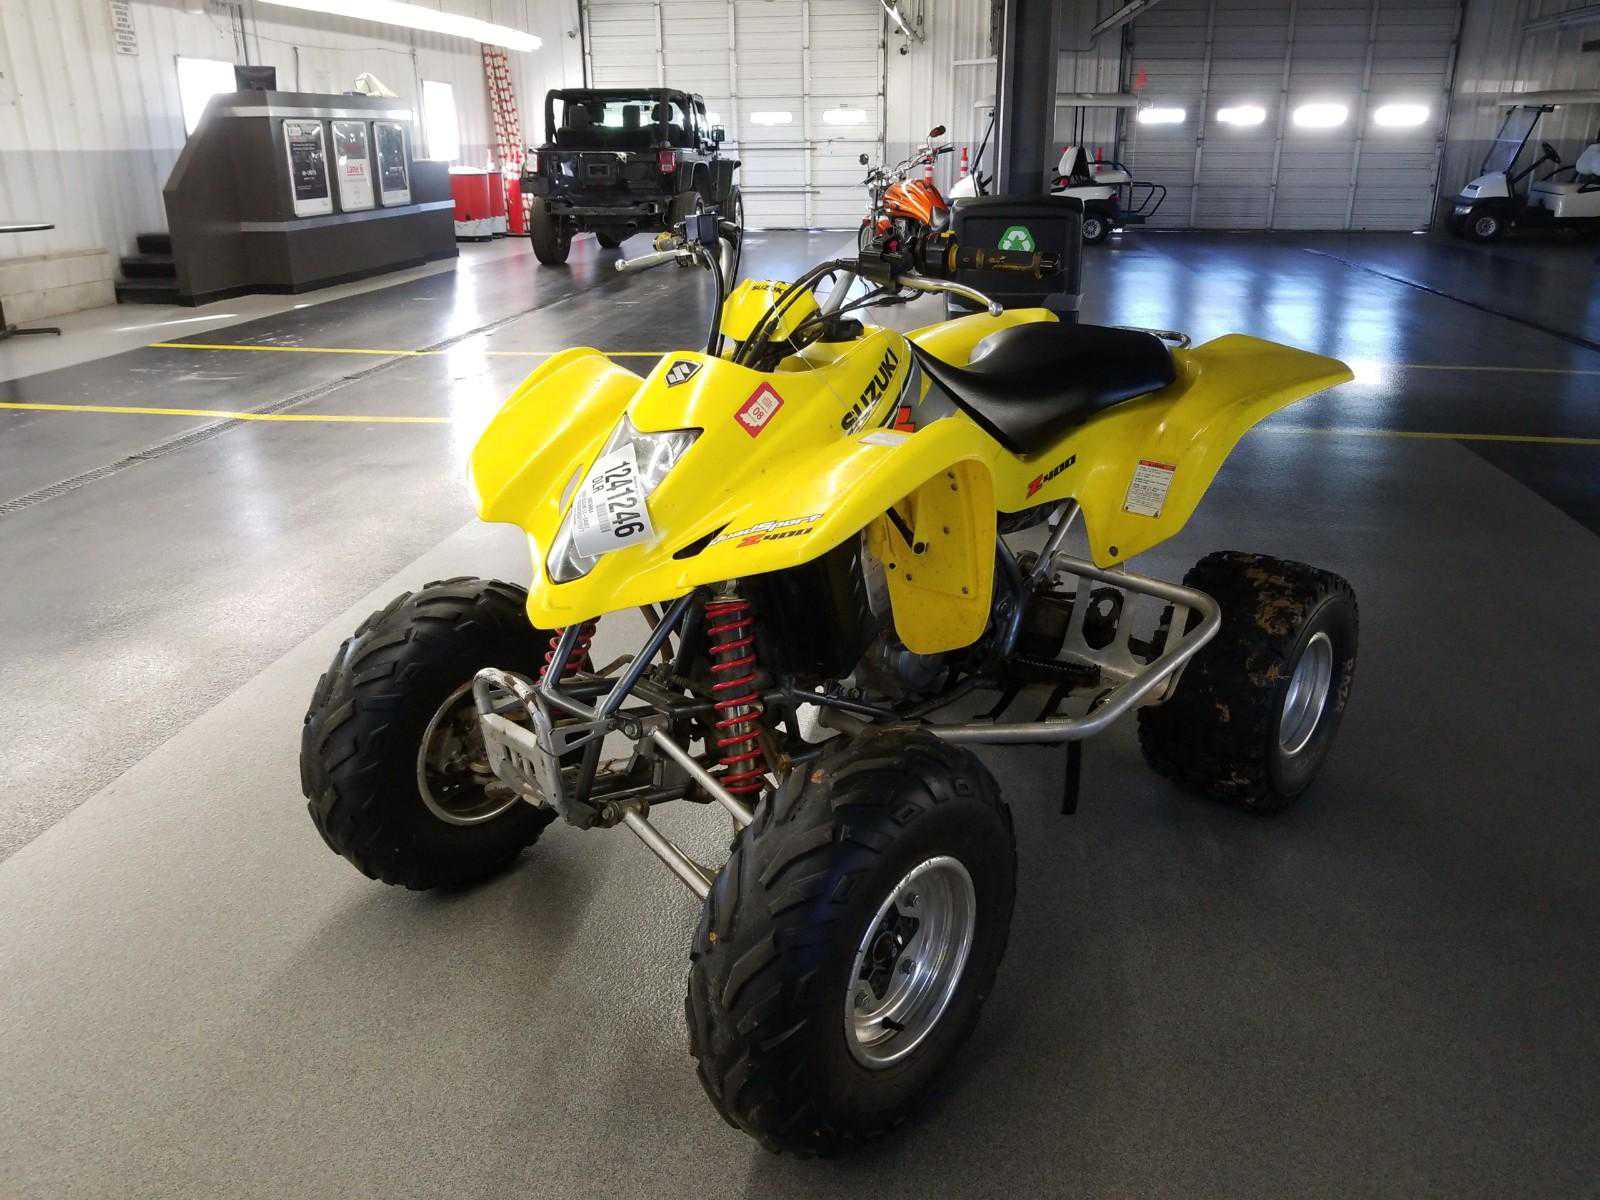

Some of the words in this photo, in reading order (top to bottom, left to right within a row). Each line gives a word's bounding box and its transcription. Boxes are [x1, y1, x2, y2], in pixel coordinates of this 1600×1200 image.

[840, 345, 900, 431] SUZUKI
[752, 407, 765, 420] 08
[592, 476, 604, 494] DLR
[605, 461, 645, 537] 1241246
